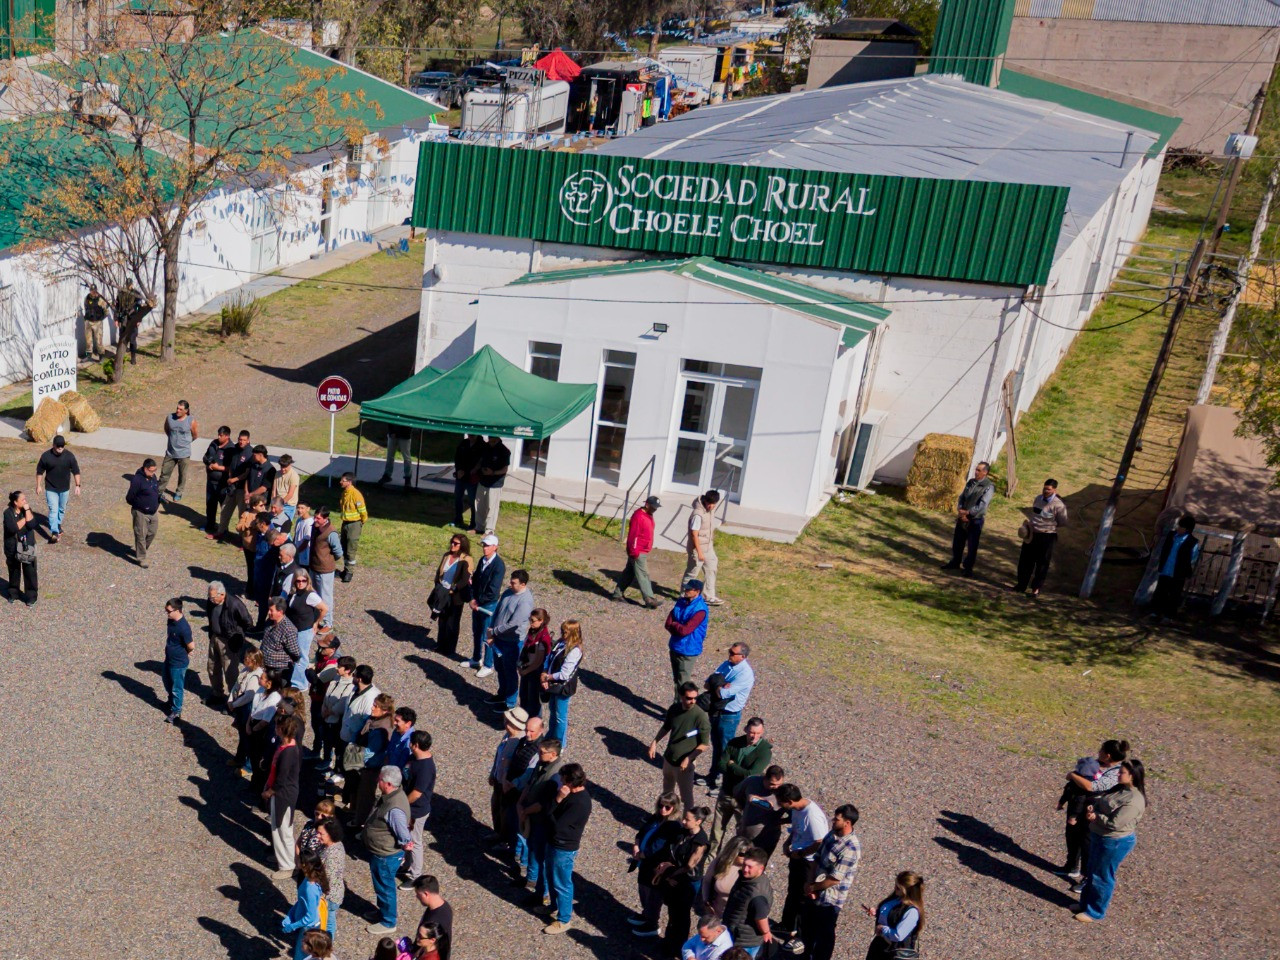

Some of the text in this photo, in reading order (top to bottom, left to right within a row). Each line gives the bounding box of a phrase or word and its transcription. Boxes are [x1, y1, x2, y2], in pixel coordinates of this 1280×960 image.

[614, 164, 877, 216] SOCIEDAD RURAL
[609, 203, 824, 246] CHOELE CHOEL
[40, 350, 69, 362] PATIO
[49, 361, 60, 369] de
[33, 367, 76, 382] COMIDAS
[38, 380, 71, 395] STAND
